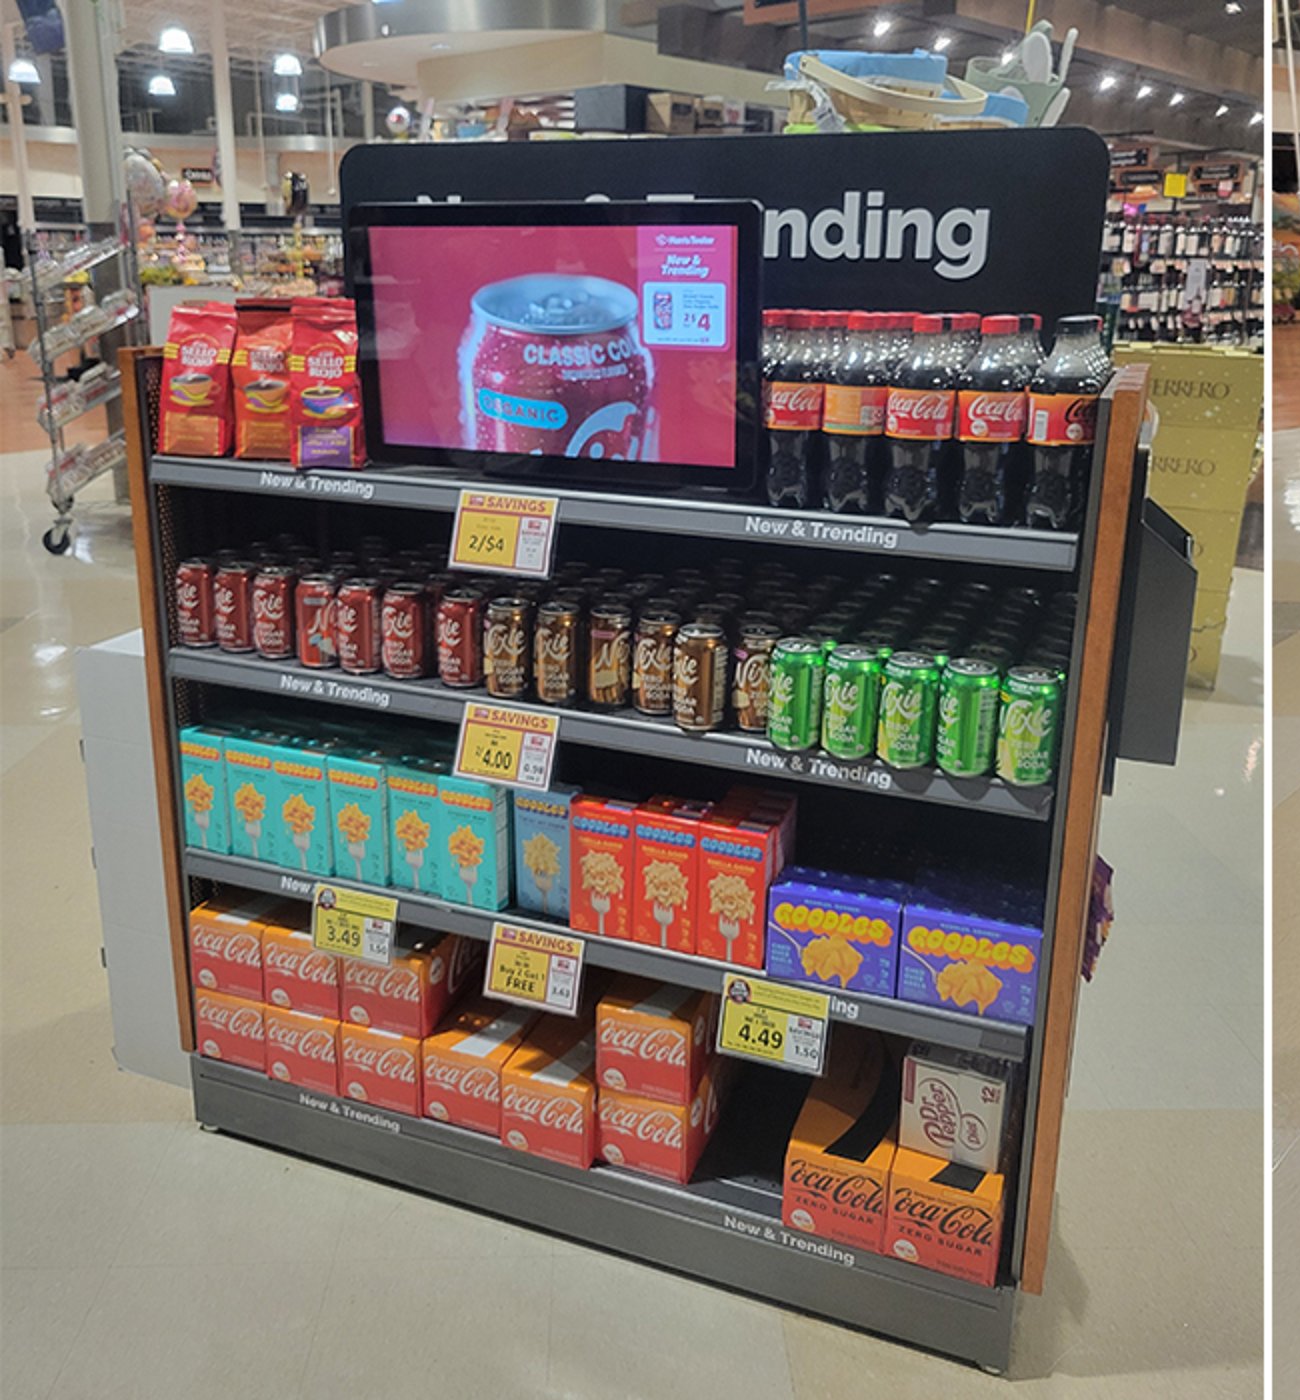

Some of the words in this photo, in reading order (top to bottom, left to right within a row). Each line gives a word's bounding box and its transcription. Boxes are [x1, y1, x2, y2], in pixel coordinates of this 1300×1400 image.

[763, 191, 991, 280] nding
[523, 343, 606, 367] CLASSIC
[1151, 378, 1231, 400] ERRERO
[260, 472, 294, 489] New
[294, 475, 306, 488] &
[308, 476, 374, 499] Trending
[487, 496, 546, 513] SAVINGS
[745, 516, 785, 535] New
[790, 519, 807, 537] &
[811, 521, 898, 549] Trending
[280, 675, 313, 692] New
[314, 681, 324, 694] &
[326, 682, 390, 707] Trending
[491, 710, 549, 729] SAVINGS
[482, 749, 513, 770] 4.00
[746, 748, 786, 769] New
[790, 755, 804, 770] &
[808, 759, 892, 790] Trending
[280, 875, 311, 895] New
[327, 925, 361, 947] 3.49
[519, 931, 574, 952] SAVINGS
[506, 976, 536, 993] FREE
[738, 1024, 783, 1049] 4.49
[982, 1085, 995, 1104] 12
[300, 1093, 328, 1111] New
[329, 1101, 341, 1115] &
[342, 1104, 401, 1133] Trending
[796, 1195, 827, 1215] ZERO
[832, 1207, 875, 1225] SUGAR
[723, 1214, 761, 1237] New
[763, 1225, 777, 1241] &
[779, 1229, 855, 1266] Trending
[898, 1225, 932, 1244] ZERO
[937, 1238, 983, 1257] SUGAR
